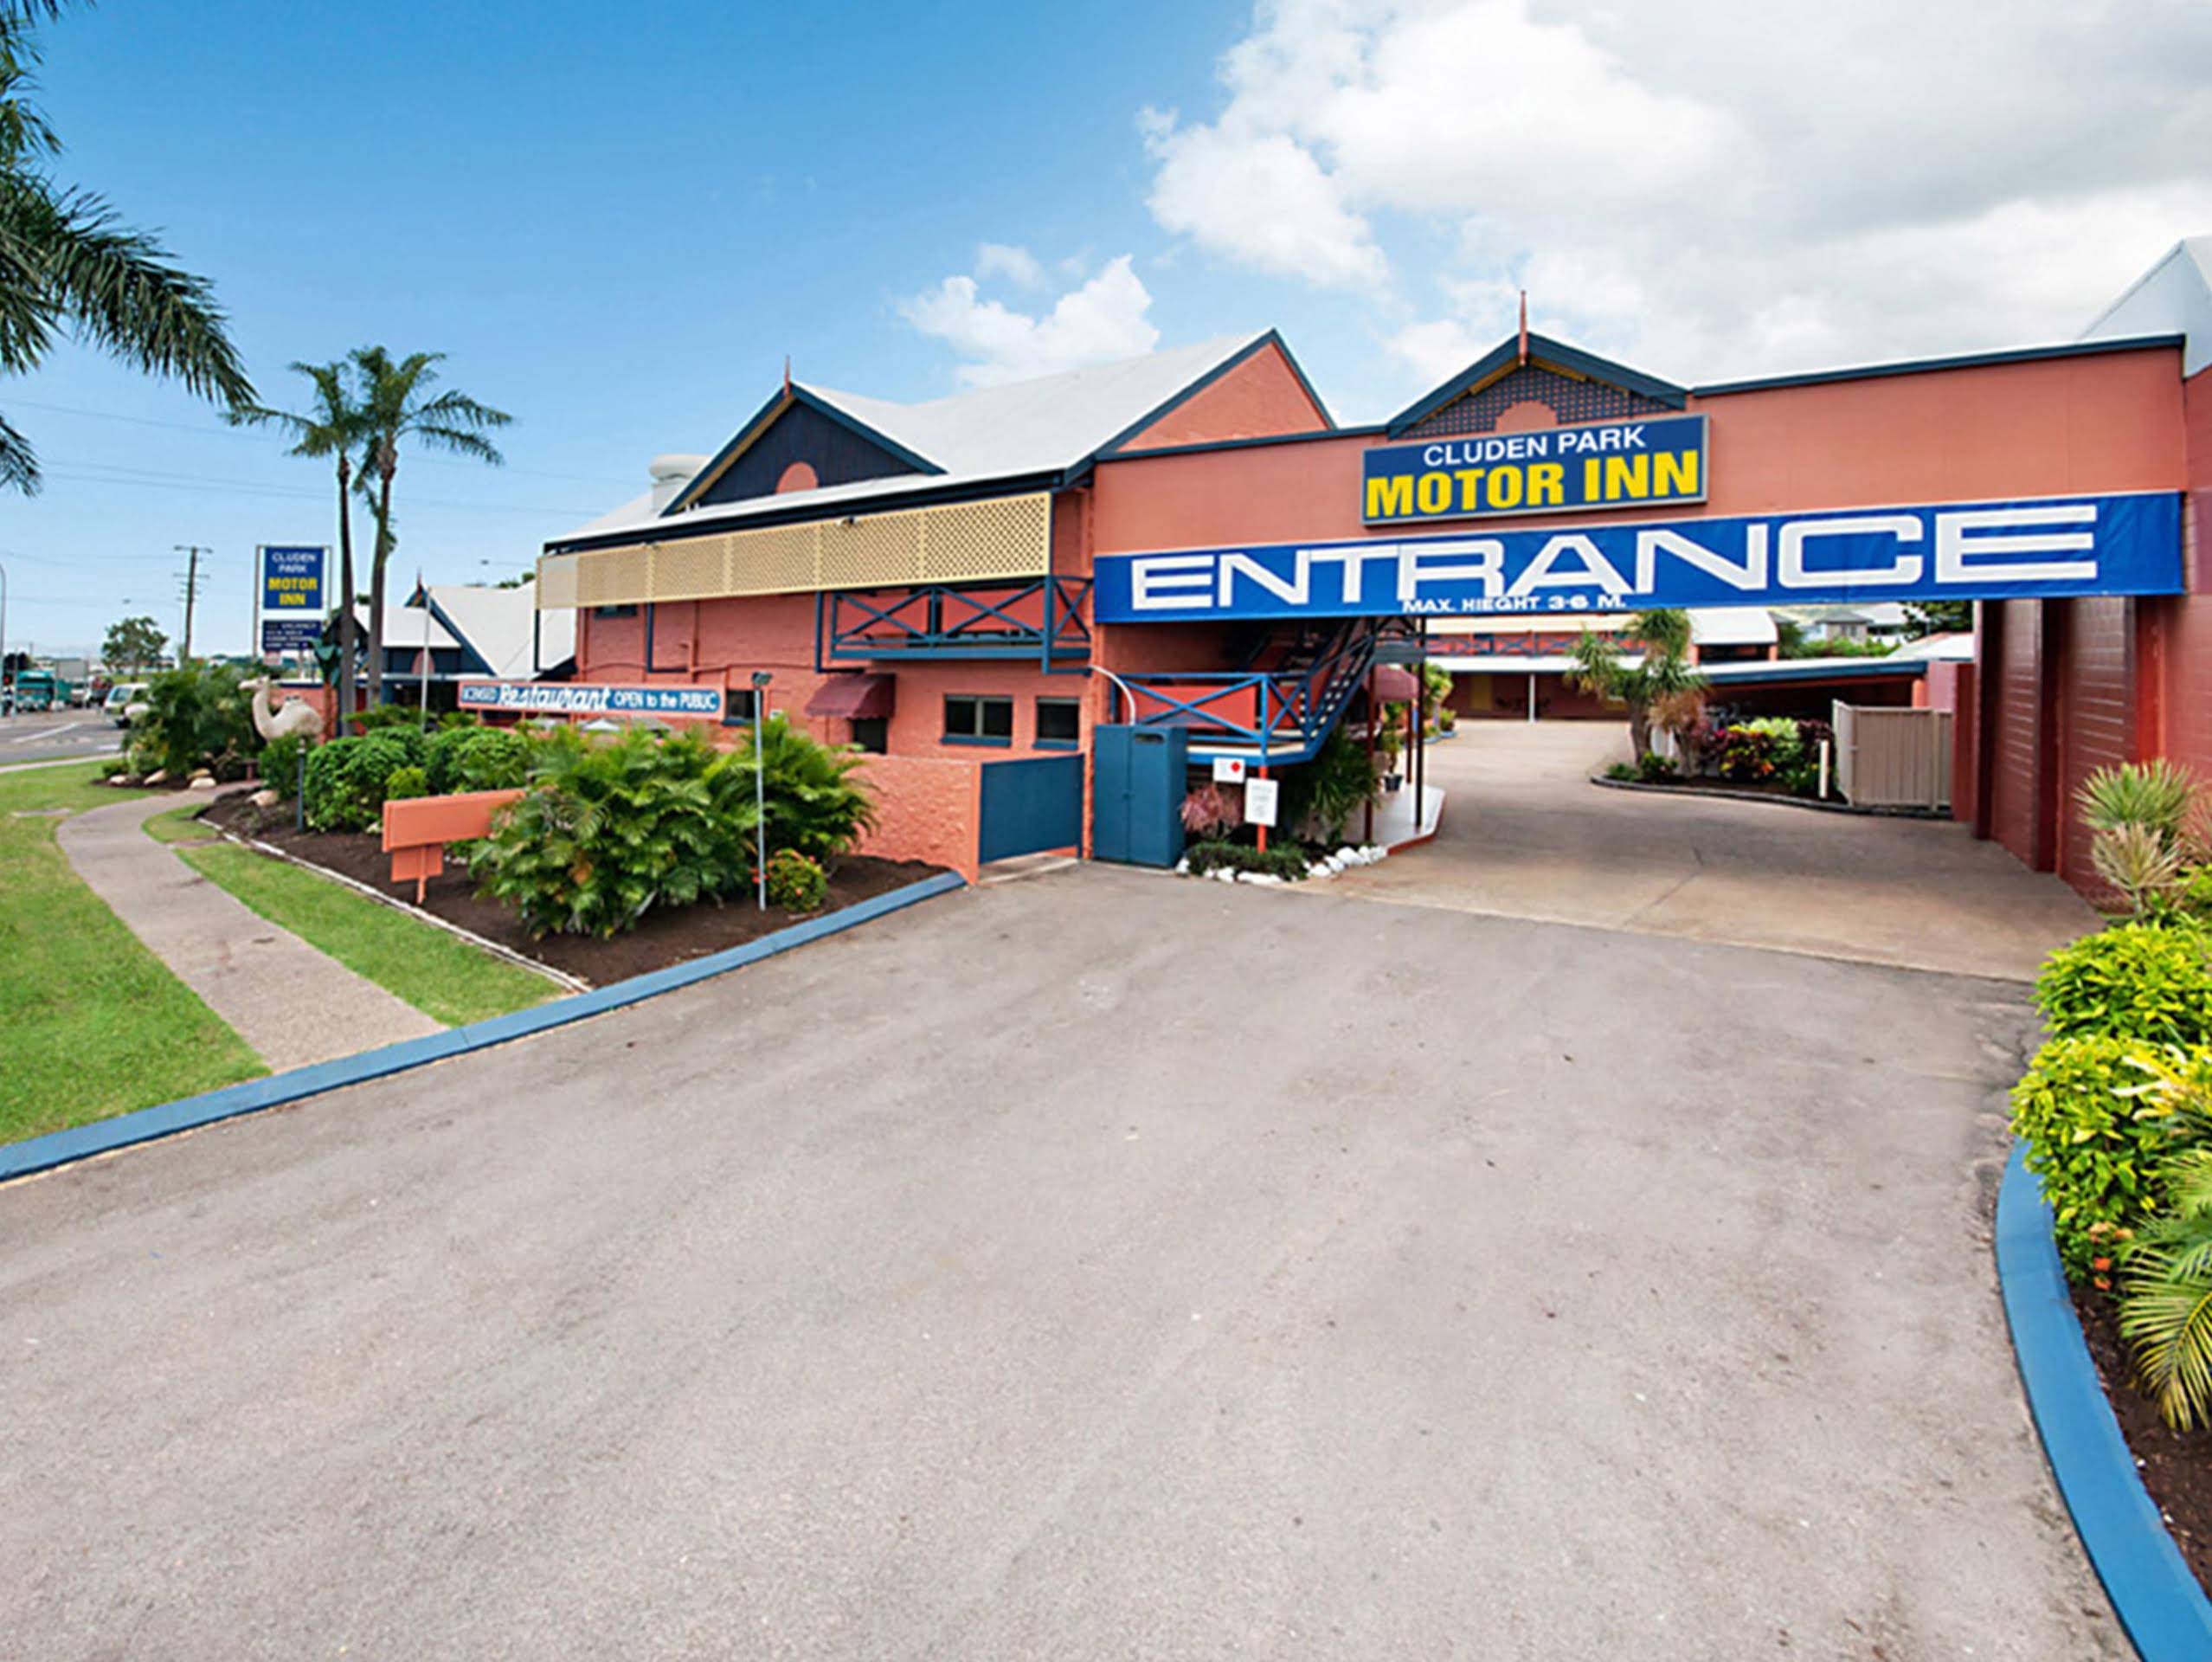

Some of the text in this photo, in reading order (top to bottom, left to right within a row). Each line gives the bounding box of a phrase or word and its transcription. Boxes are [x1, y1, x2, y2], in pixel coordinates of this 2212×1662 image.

[1424, 426, 1646, 467] CLUDEN PARK
[1366, 449, 1699, 519] MOTOR INN
[271, 552, 318, 564] CLUDEN
[1131, 505, 2098, 611] ENTRANCE
[278, 564, 307, 574] PARK
[267, 577, 318, 591] MOTOR
[279, 593, 305, 605] INN
[1462, 596, 1540, 612] HIEGHT
[498, 683, 611, 712] Restaurant
[614, 691, 644, 708] OPEN
[646, 692, 658, 708] to
[659, 692, 678, 708] the
[679, 691, 717, 710] PUBLIC
